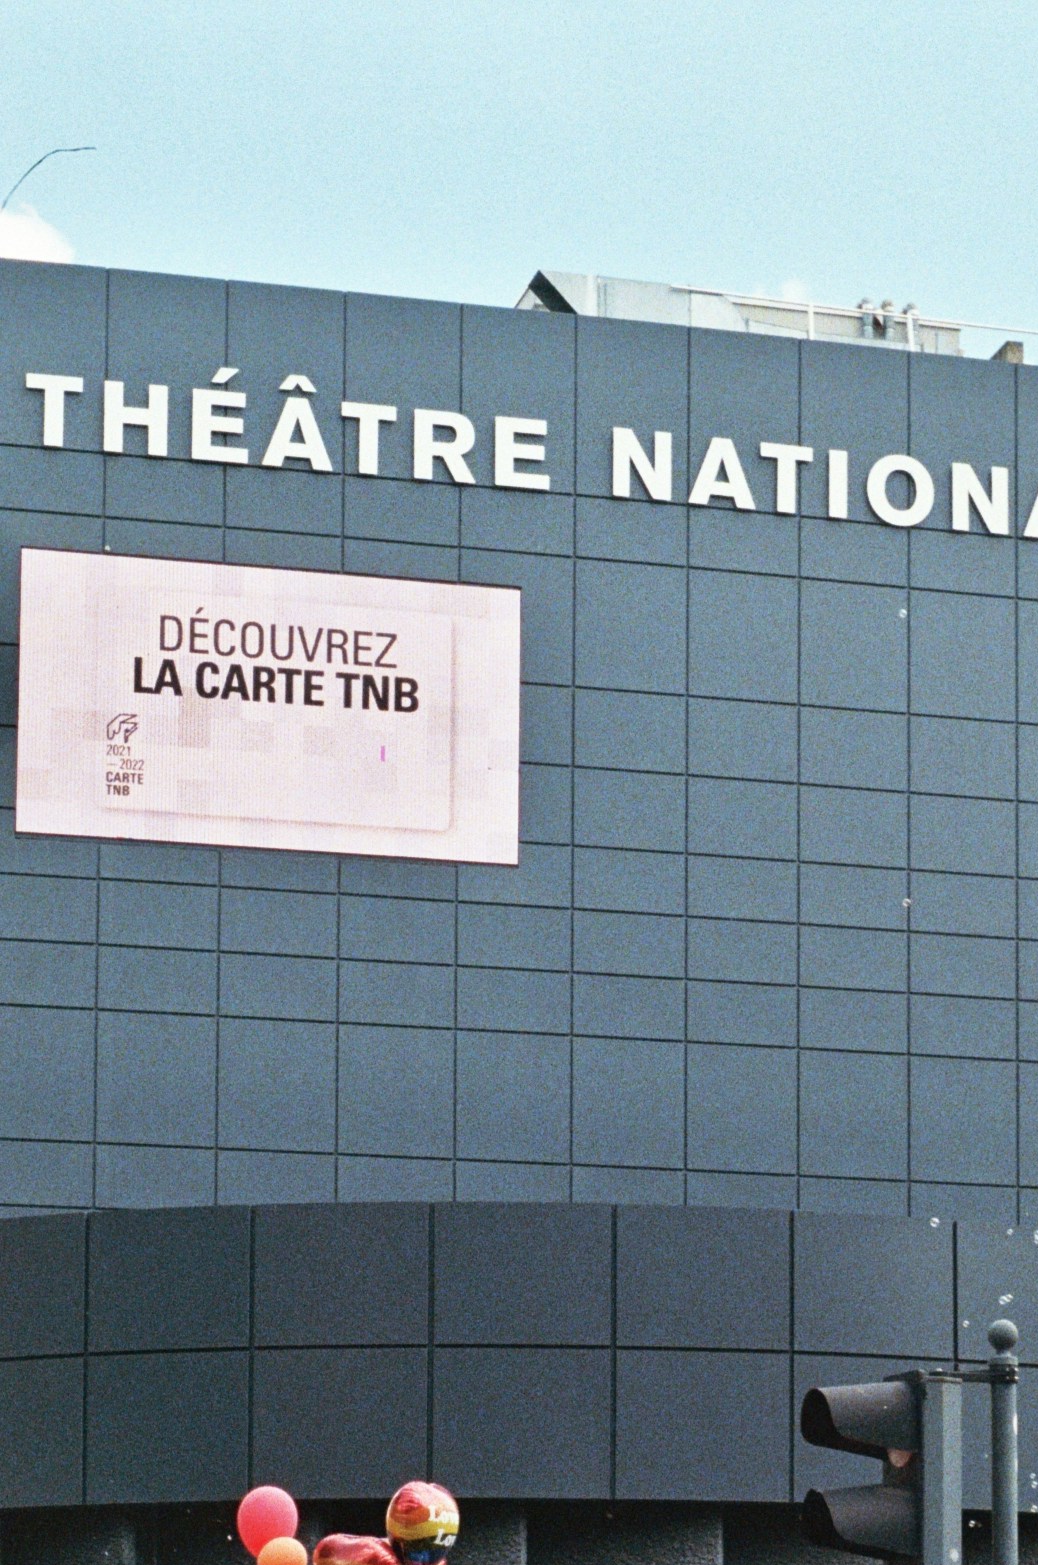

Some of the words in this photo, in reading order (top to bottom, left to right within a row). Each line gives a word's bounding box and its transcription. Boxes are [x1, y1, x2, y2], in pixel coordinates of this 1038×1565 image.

[26, 367, 551, 491] THÉÂTRE
[159, 608, 398, 668] DÉCOUVREZ
[133, 657, 182, 696] LA
[195, 663, 325, 706] CARTE
[337, 673, 419, 713] TNB
[106, 744, 131, 756] 2021
[119, 758, 144, 771] 2022
[106, 771, 144, 784] CARTE
[106, 783, 130, 796] TNB
